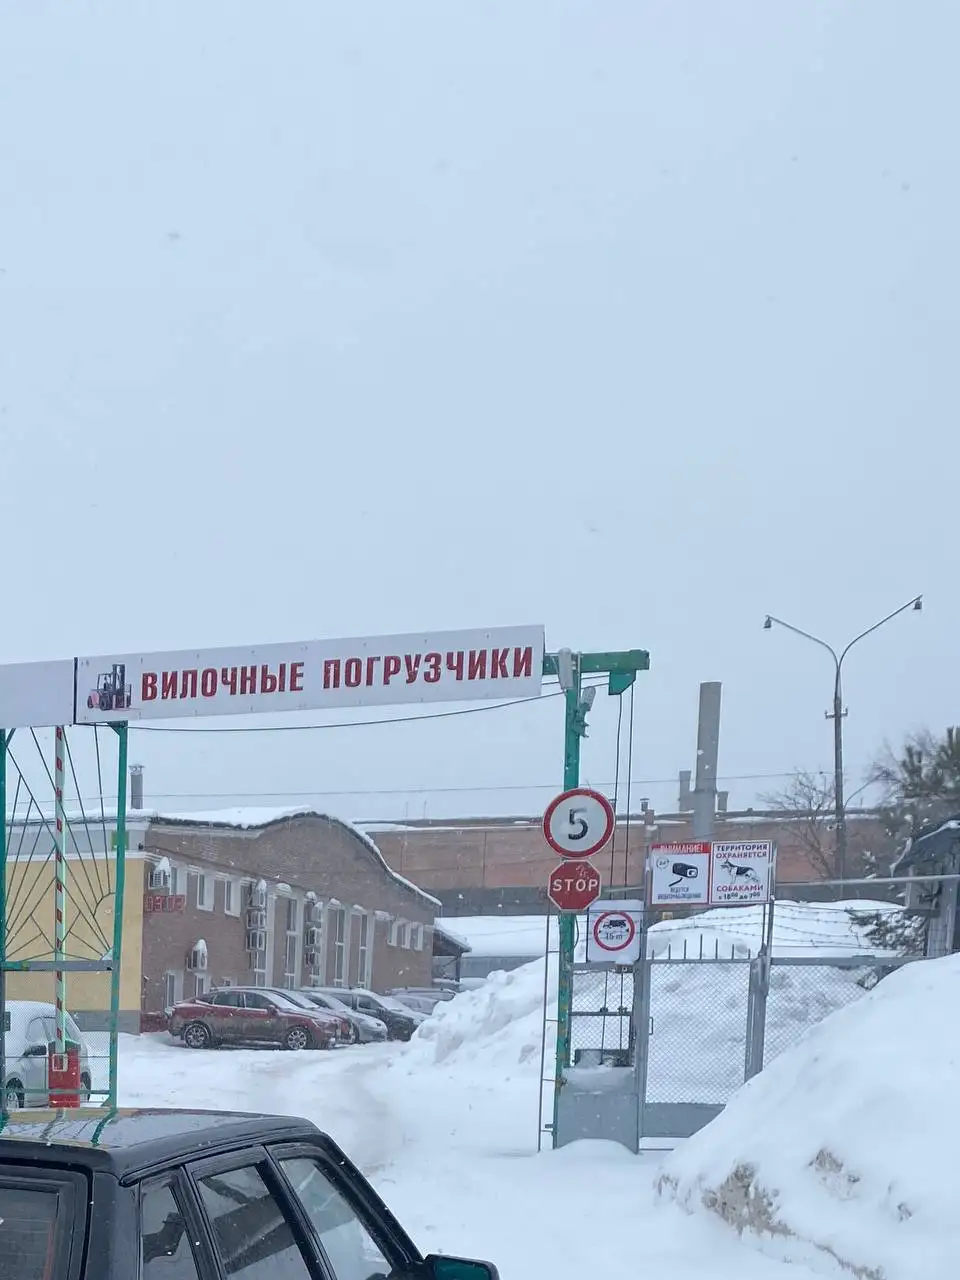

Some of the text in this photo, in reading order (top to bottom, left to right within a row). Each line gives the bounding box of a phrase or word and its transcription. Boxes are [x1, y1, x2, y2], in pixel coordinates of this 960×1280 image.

[142, 646, 533, 701] ВИЛОЧНЫЕ ПОГРУЗЧИКИ
[568, 807, 589, 840] 5
[717, 843, 768, 852] ТЕРРИТОРИЯ
[716, 851, 767, 859] ОХРАНЯЕТСЯ
[552, 879, 598, 892] STOP
[716, 884, 764, 892] СОБАКАМИ
